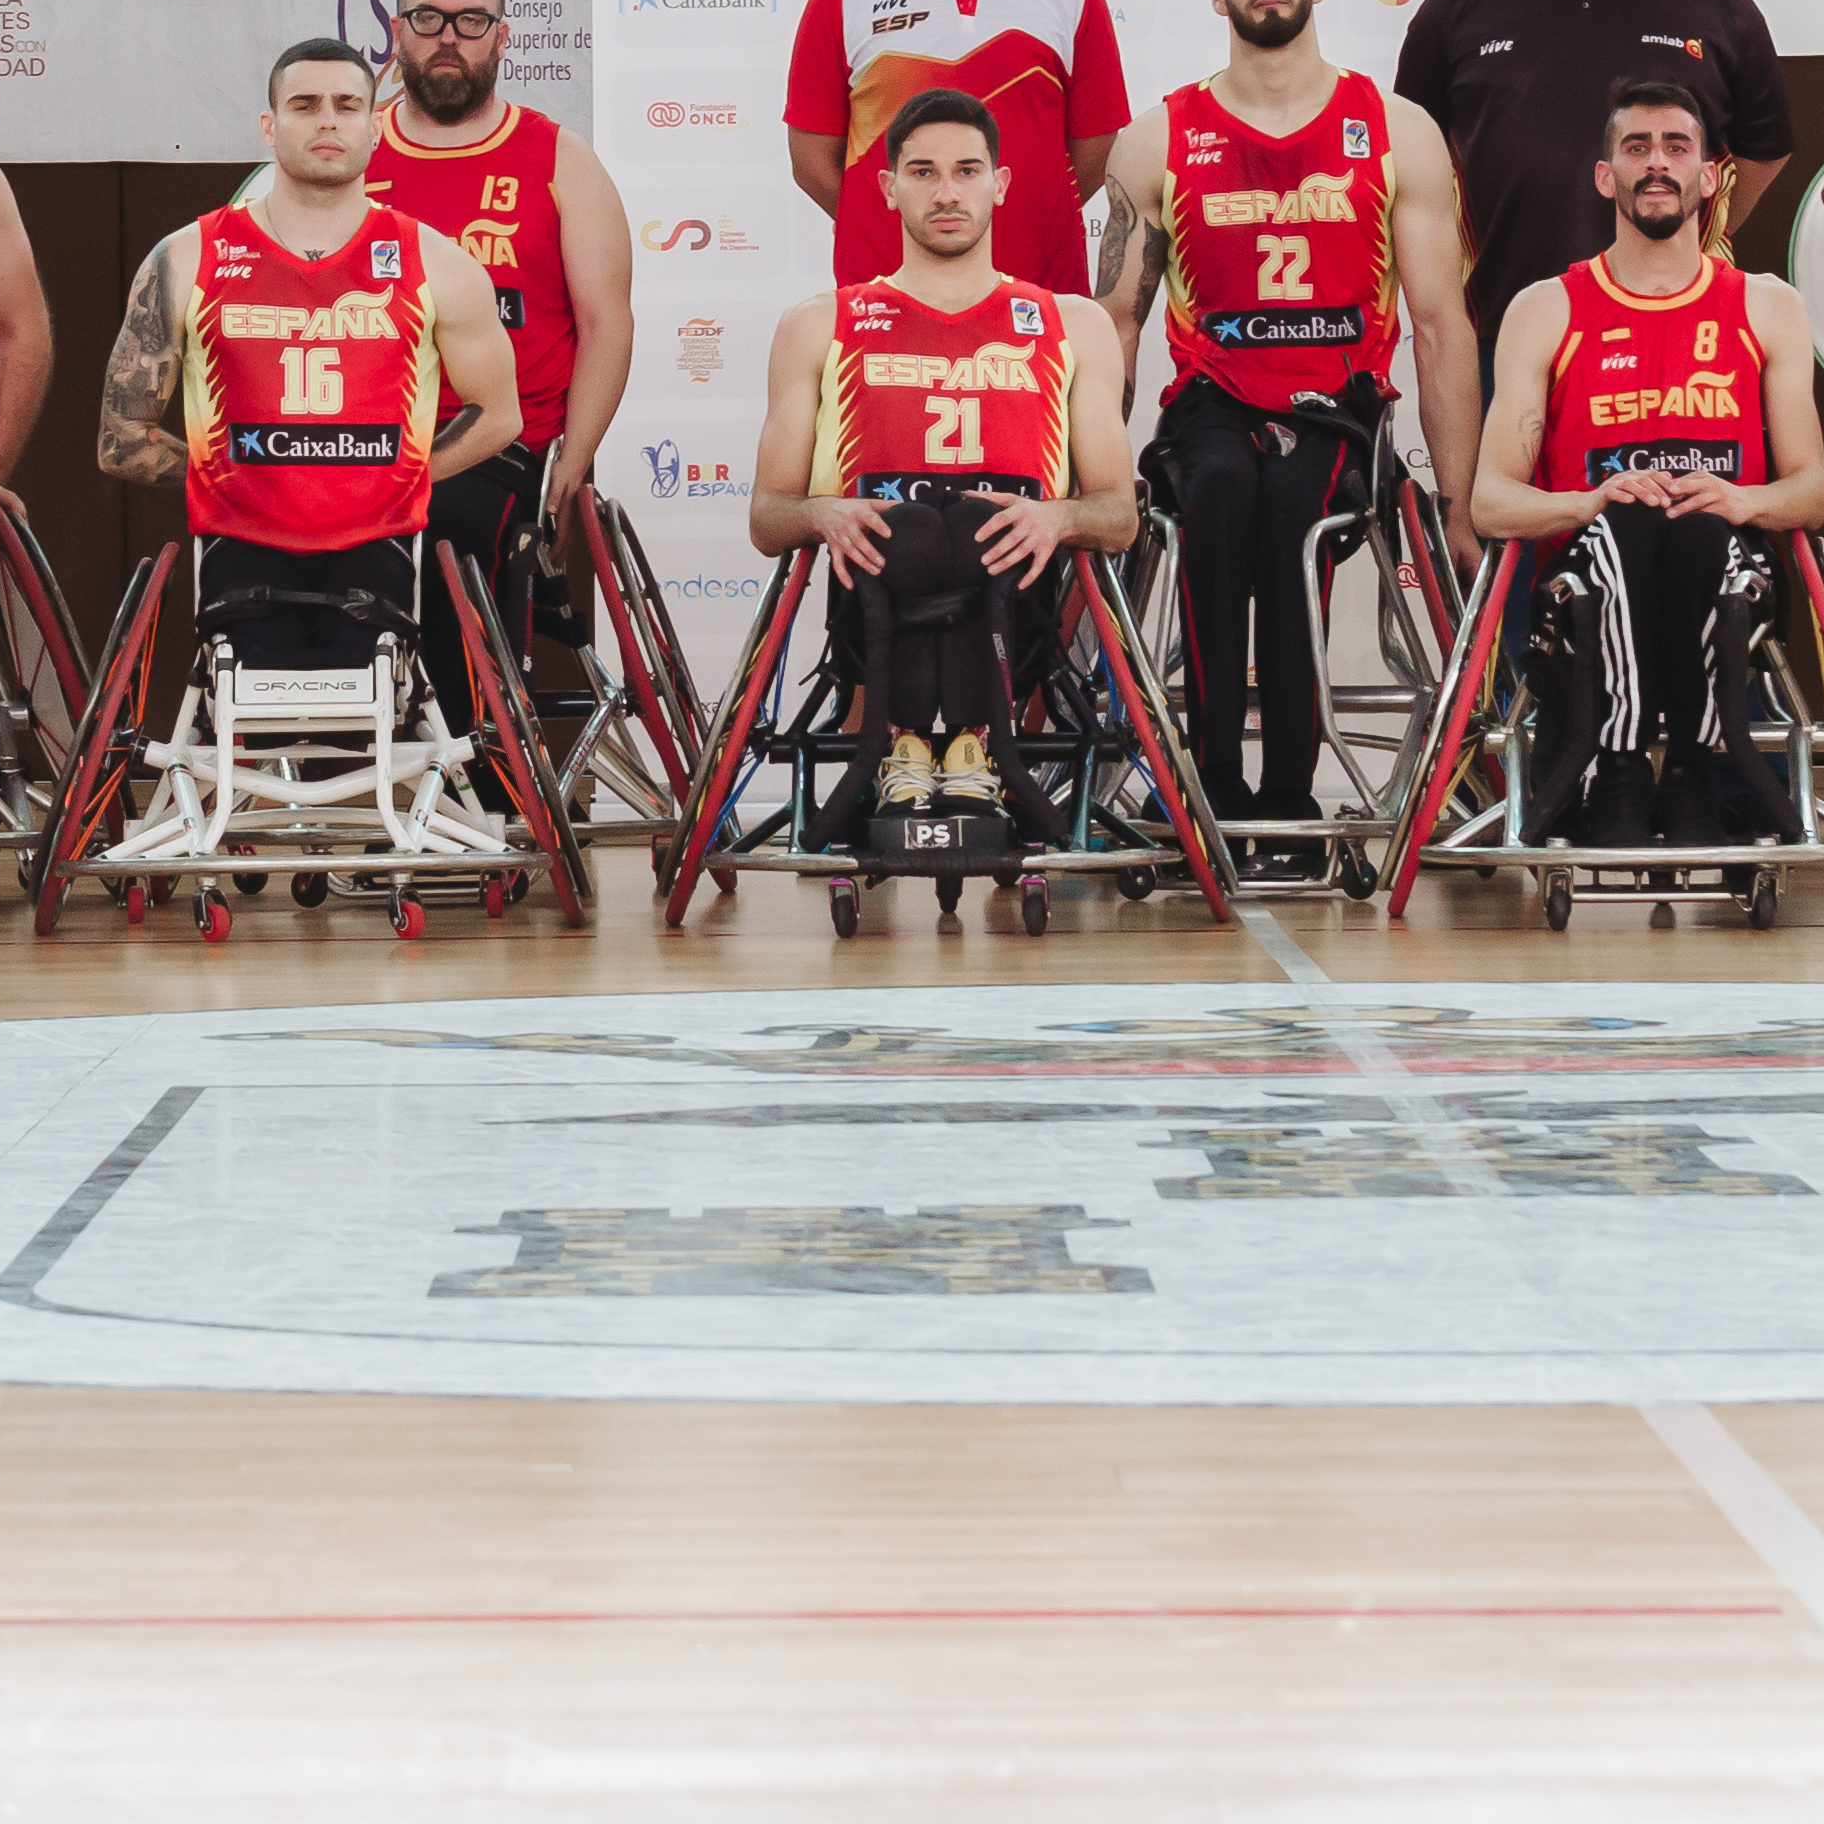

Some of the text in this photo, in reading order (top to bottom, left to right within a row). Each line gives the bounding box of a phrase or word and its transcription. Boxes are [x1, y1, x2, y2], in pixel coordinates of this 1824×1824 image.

[574, 26, 592, 49] de
[871, 10, 931, 36] ESP
[1641, 33, 1685, 49] amiab
[503, 58, 572, 87] Deportes
[689, 113, 737, 125] ONCE
[479, 174, 520, 213] 13
[1201, 167, 1358, 227] ESPAÑA
[1255, 234, 1314, 301] 22
[220, 283, 401, 342] ESPAÑA
[1246, 315, 1358, 341] CaixaBank
[1692, 319, 1720, 362] 8
[278, 345, 344, 416] 16
[863, 339, 1041, 394] ESPAÑA
[1588, 370, 1741, 427] ESPAÑA
[924, 394, 985, 465] 21
[267, 430, 394, 459] CaixaBank
[687, 482, 753, 497] ESPAÑ
[657, 573, 760, 599] ndesa
[916, 824, 951, 844] PS
